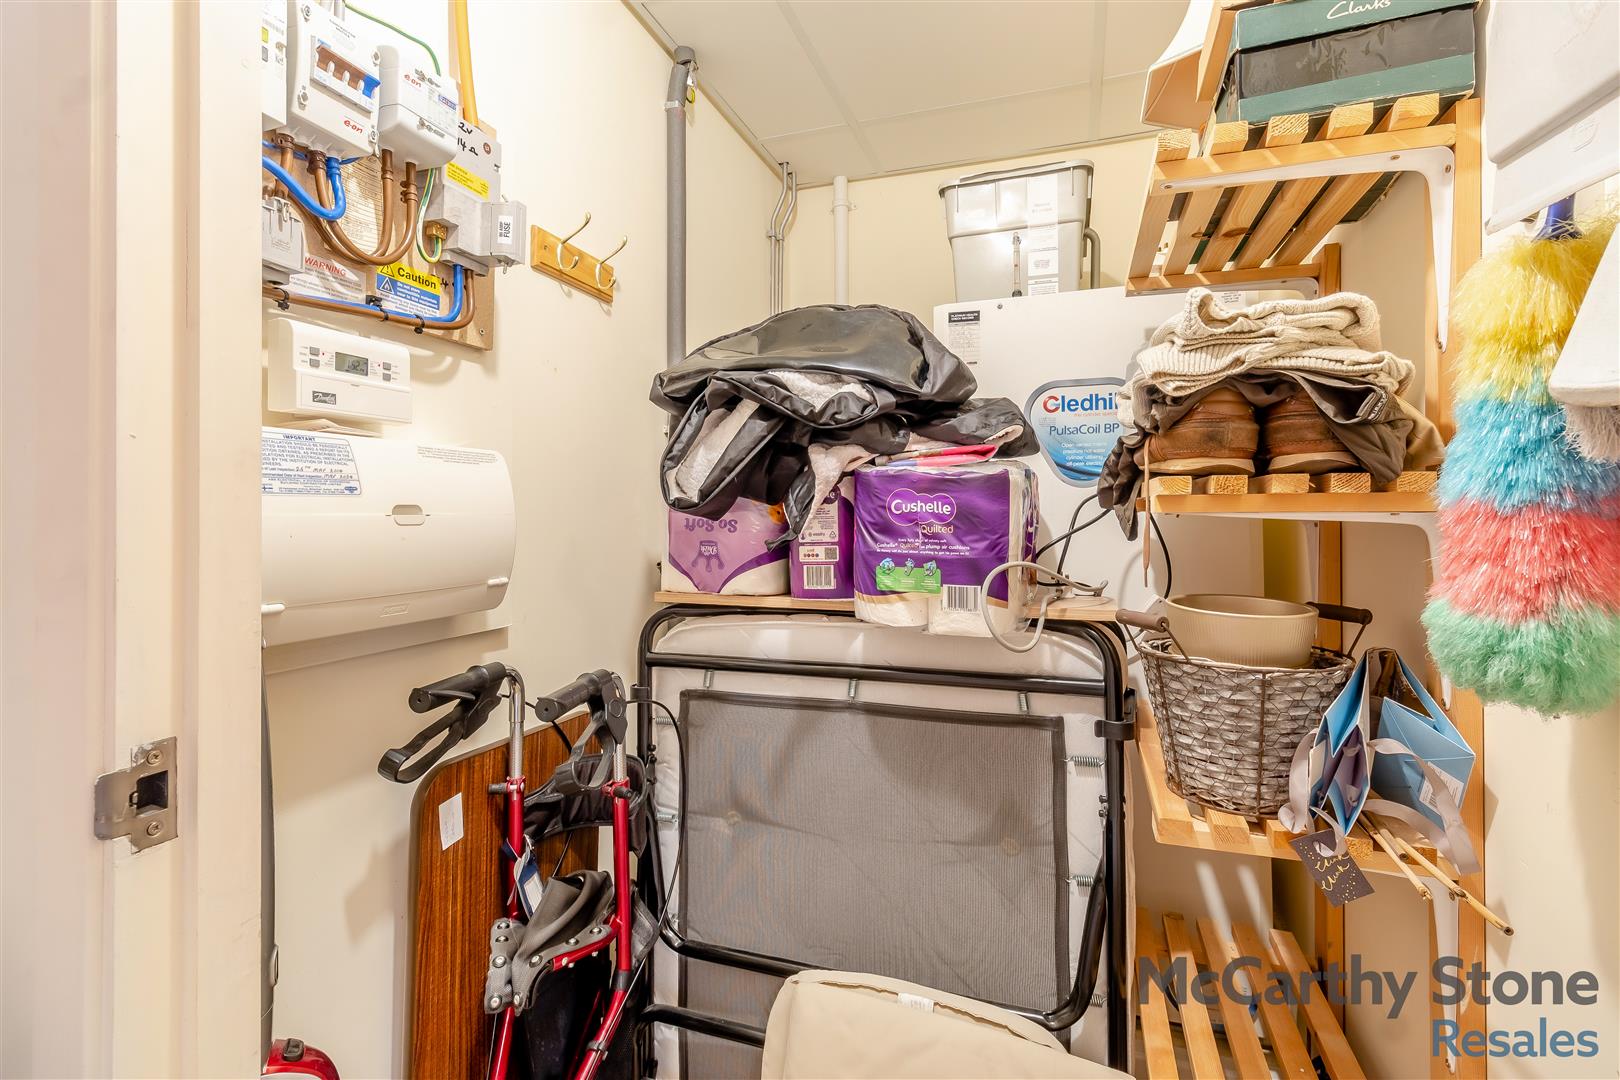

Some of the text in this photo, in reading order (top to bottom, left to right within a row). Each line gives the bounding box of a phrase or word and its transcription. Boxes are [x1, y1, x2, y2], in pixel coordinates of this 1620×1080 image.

[1327, 0, 1391, 20] Clarks
[503, 221, 511, 238] FUSE
[304, 256, 346, 277] WARNING
[397, 267, 436, 289] Caution
[1049, 422, 1120, 436] PulsaCoil BP
[891, 499, 951, 516] Cushelle
[684, 517, 738, 533] So Soft
[920, 525, 953, 535] Quilted
